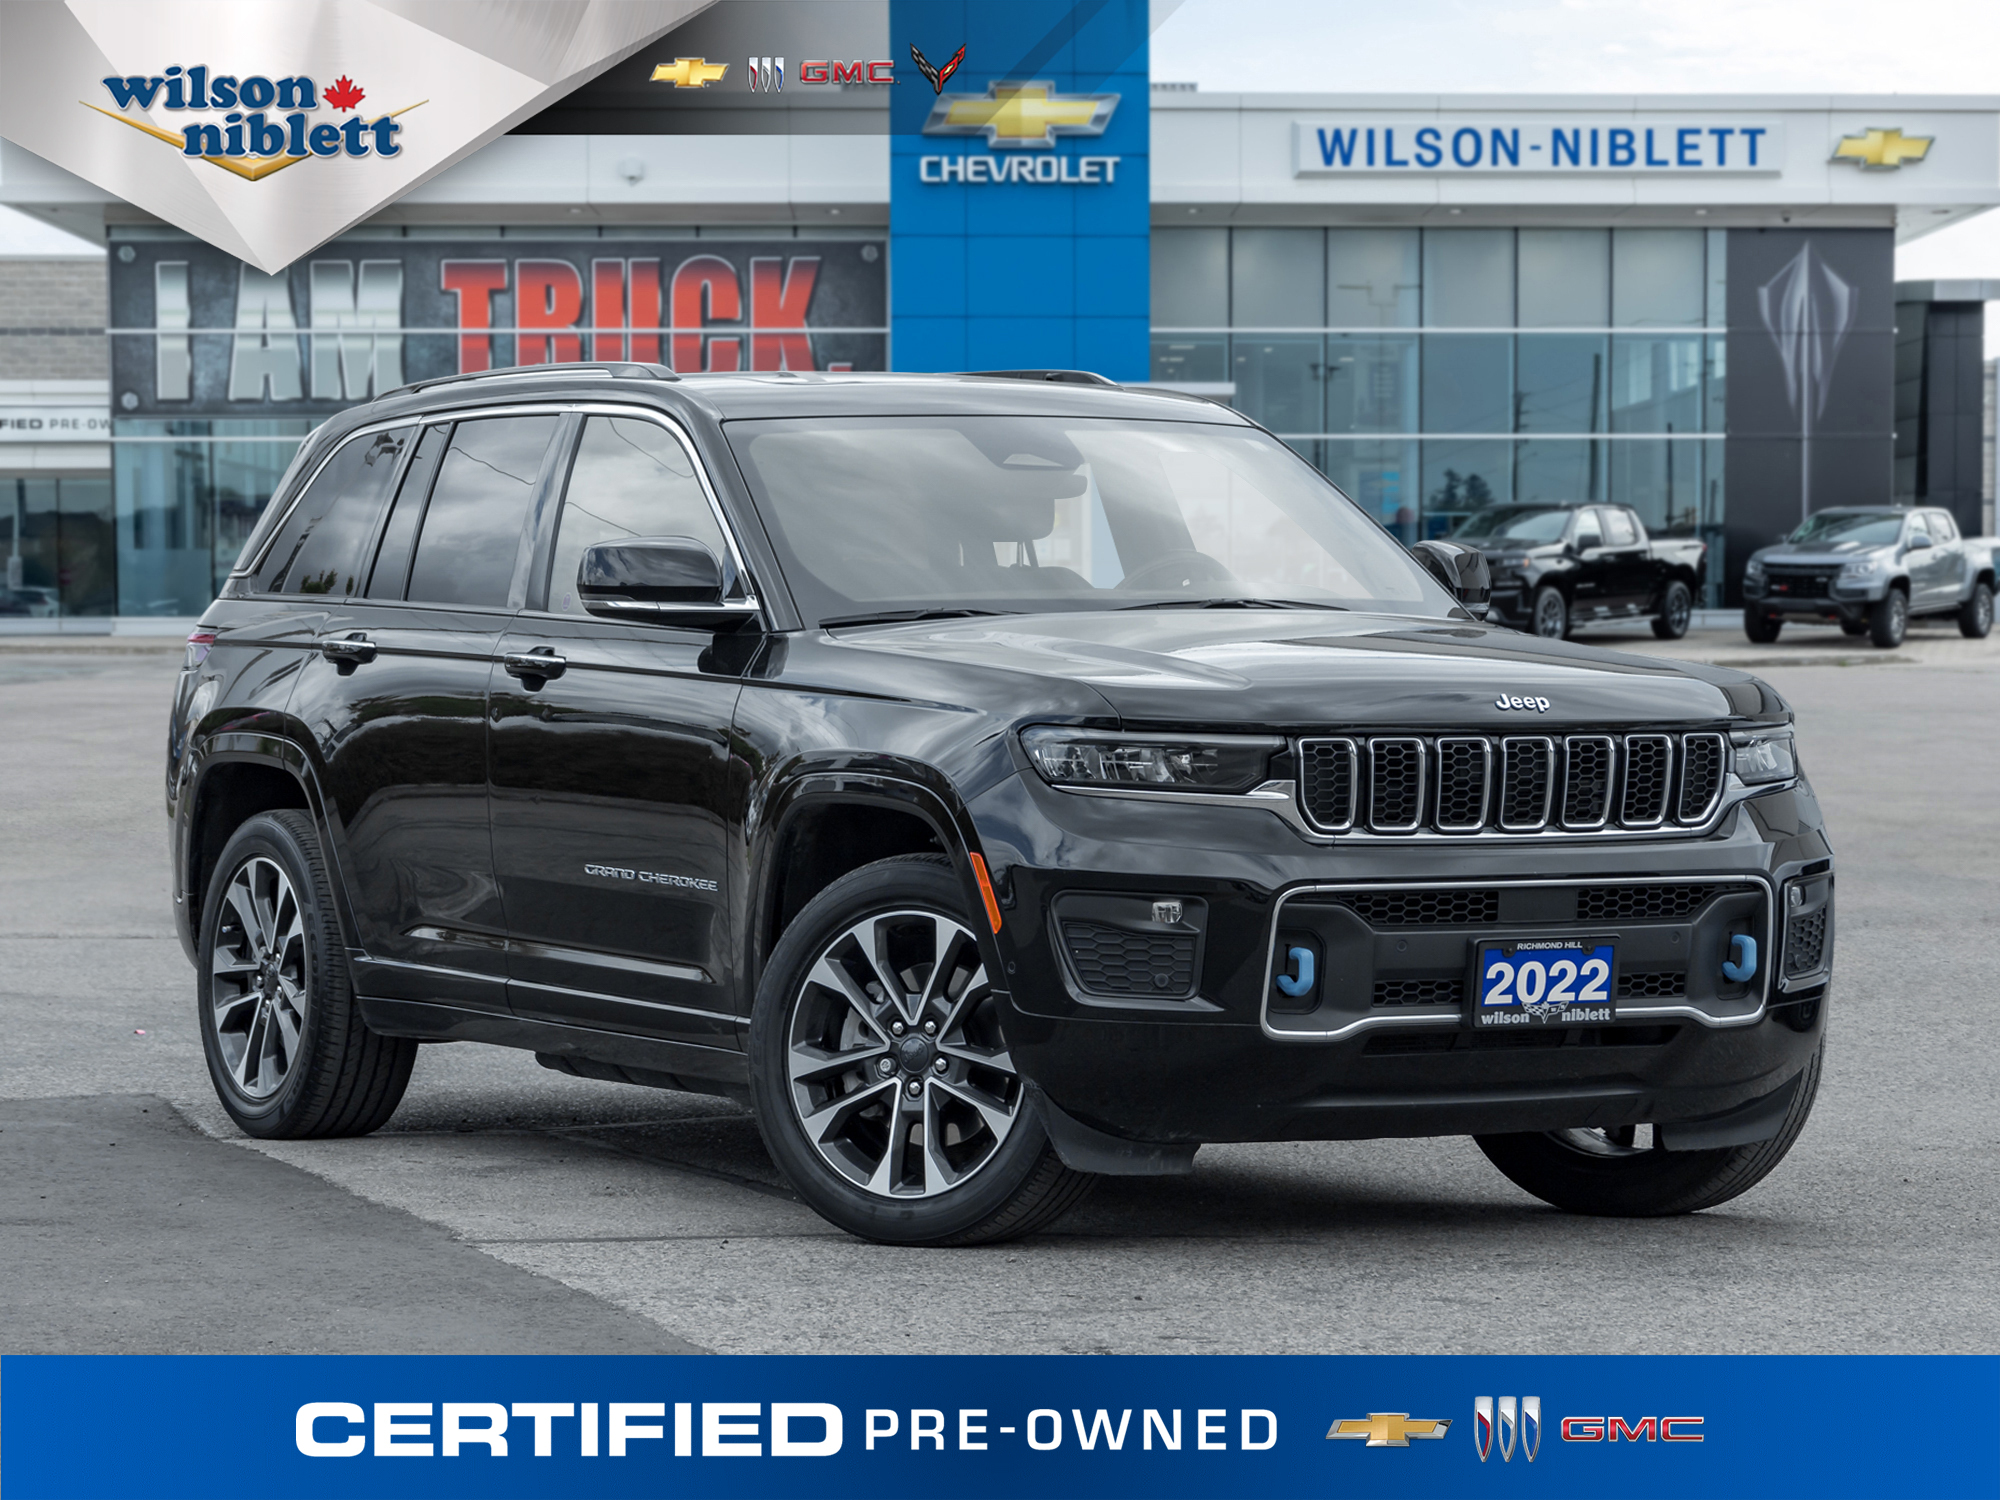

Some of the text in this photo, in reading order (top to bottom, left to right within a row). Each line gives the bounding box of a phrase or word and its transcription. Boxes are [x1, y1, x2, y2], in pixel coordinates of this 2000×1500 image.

[920, 155, 1120, 184] CHEVROLET
[155, 255, 852, 402] I AM TRUCK
[1495, 693, 1551, 713] Jeep
[584, 864, 719, 891] GRAND CHEROKEE
[1516, 941, 1583, 951] RICHMOND HILL
[1484, 958, 1610, 1006] 2022
[1481, 1007, 1611, 1025] wilson niblett
